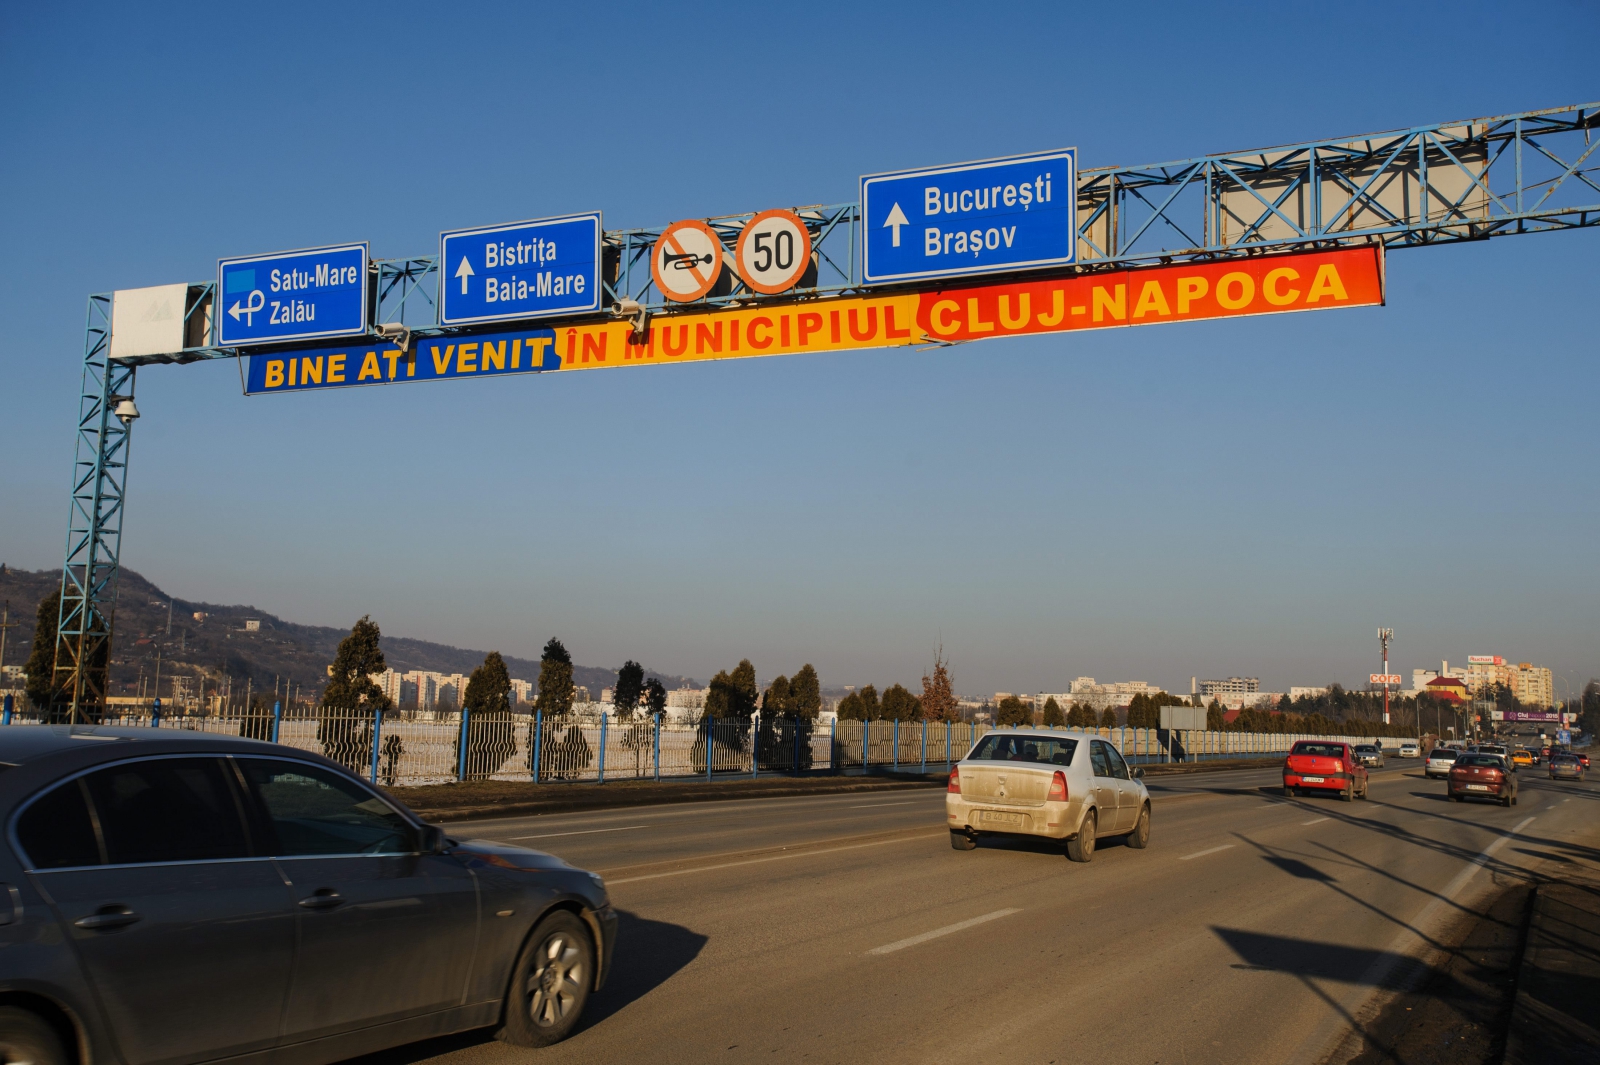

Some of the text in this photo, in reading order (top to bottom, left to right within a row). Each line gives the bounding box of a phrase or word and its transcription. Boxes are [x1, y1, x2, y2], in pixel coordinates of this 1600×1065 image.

[924, 172, 1052, 216] București
[485, 238, 557, 270] Bistrița
[753, 229, 794, 273] 50
[924, 225, 1017, 258] Brașov
[270, 263, 358, 293] Satu-Mare
[485, 272, 586, 303] Baia-Mare
[264, 353, 347, 388] BINE
[431, 337, 553, 375] VENIT
[565, 328, 608, 364] ÎN
[623, 304, 911, 360] MUNICIPIUL
[929, 263, 1349, 336] CLUJ-NAPOCA
[269, 300, 316, 326] Zalău
[1370, 674, 1401, 683] cora
